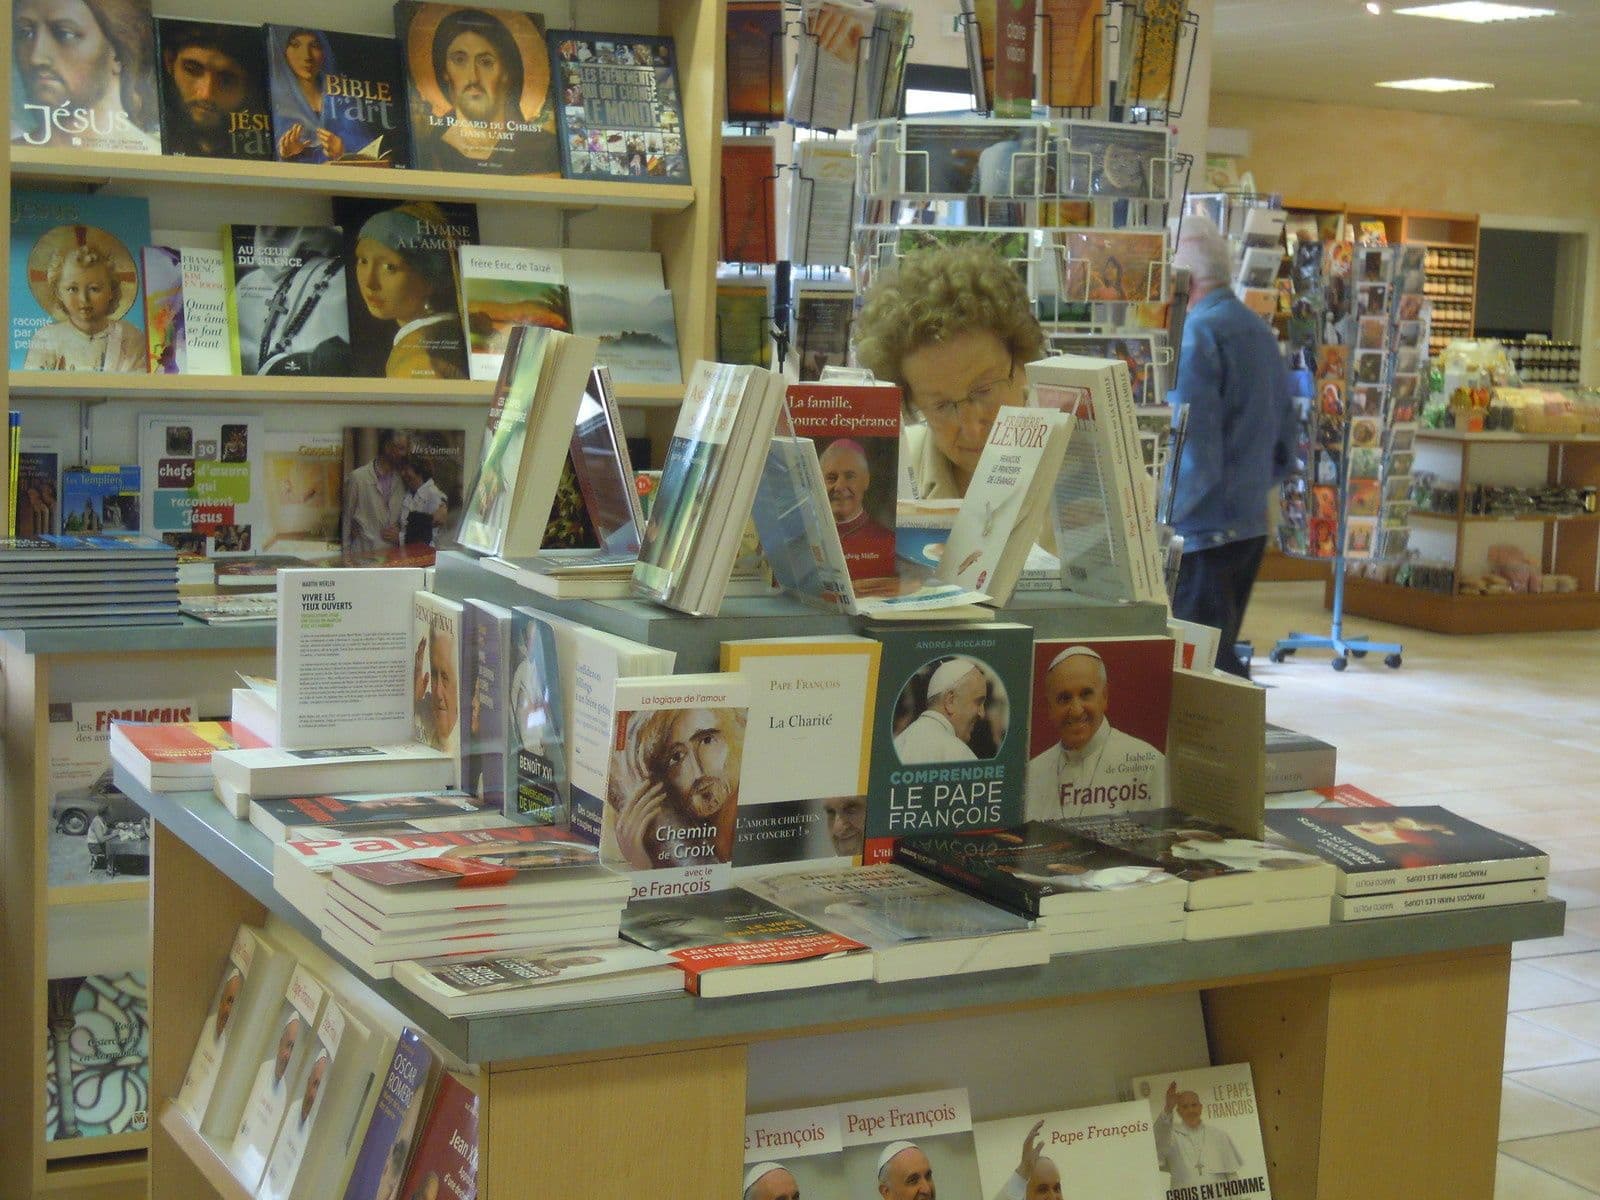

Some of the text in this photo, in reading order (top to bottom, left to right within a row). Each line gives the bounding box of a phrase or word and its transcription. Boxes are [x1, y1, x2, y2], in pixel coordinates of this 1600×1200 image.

[326, 74, 392, 103] BIBLE
[330, 96, 396, 130] l'art
[24, 101, 129, 145] Jésus
[416, 220, 471, 238] HYMNE
[237, 246, 254, 255] AU
[238, 256, 303, 267] DU SILENCE
[788, 395, 804, 408] La
[830, 414, 897, 431] d'espérance
[990, 422, 1048, 448] LENOIR
[182, 510, 224, 526] Jésus
[301, 593, 336, 602] VIVRE LES
[301, 602, 353, 611] YEUX OUVERTS
[954, 639, 996, 649] RICCARDI
[641, 694, 727, 707] La logique de l'amour
[769, 713, 833, 729] La Charité
[519, 755, 541, 776] BENOÎT
[889, 765, 1005, 785] COMPRENDRE
[890, 781, 1003, 811] LE PAPE
[888, 804, 1001, 831] FRANÇOIS
[655, 823, 717, 841] Chemin
[658, 842, 715, 860] de Croix
[684, 867, 713, 877] avec le
[650, 877, 712, 898] François
[1213, 1081, 1252, 1101] LE PAPE
[1207, 1100, 1255, 1119] FRANÇOIS
[847, 1103, 956, 1137] Pape François
[755, 1123, 825, 1148] François
[1051, 1121, 1149, 1146] Pape François
[1165, 1176, 1266, 1200] CROIS EN L'HOMME
